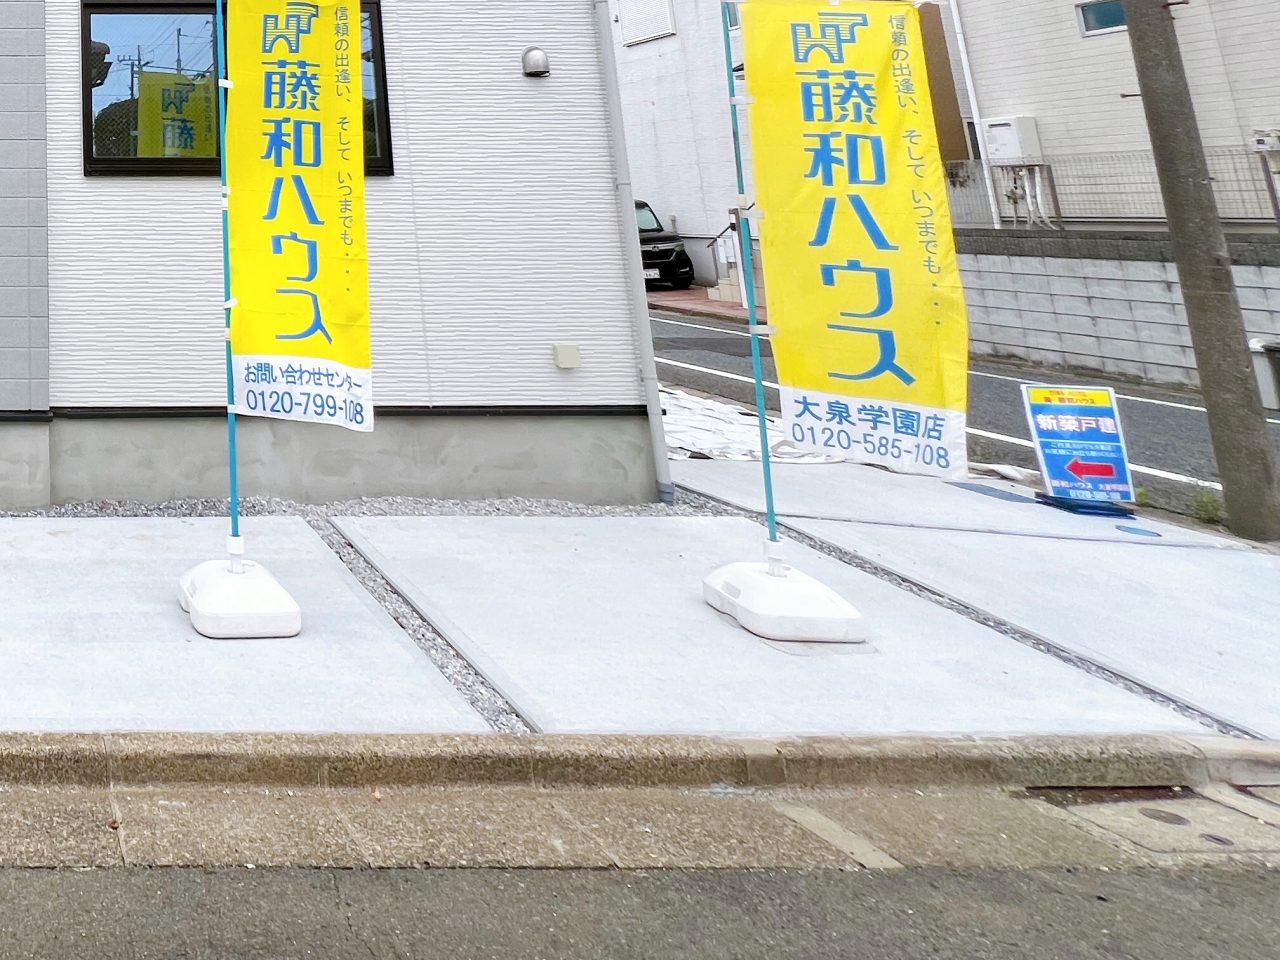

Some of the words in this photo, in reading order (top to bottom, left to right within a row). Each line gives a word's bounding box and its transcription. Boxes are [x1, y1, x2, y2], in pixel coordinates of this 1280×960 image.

[260, 59, 333, 345] 藤和ハウス
[794, 69, 916, 386] 藤和ハウス
[244, 362, 362, 392] お問い合わせセンター
[246, 389, 364, 424] 0120-799-108
[794, 395, 946, 441] 大泉学園店
[792, 423, 950, 469] 0120-585-108
